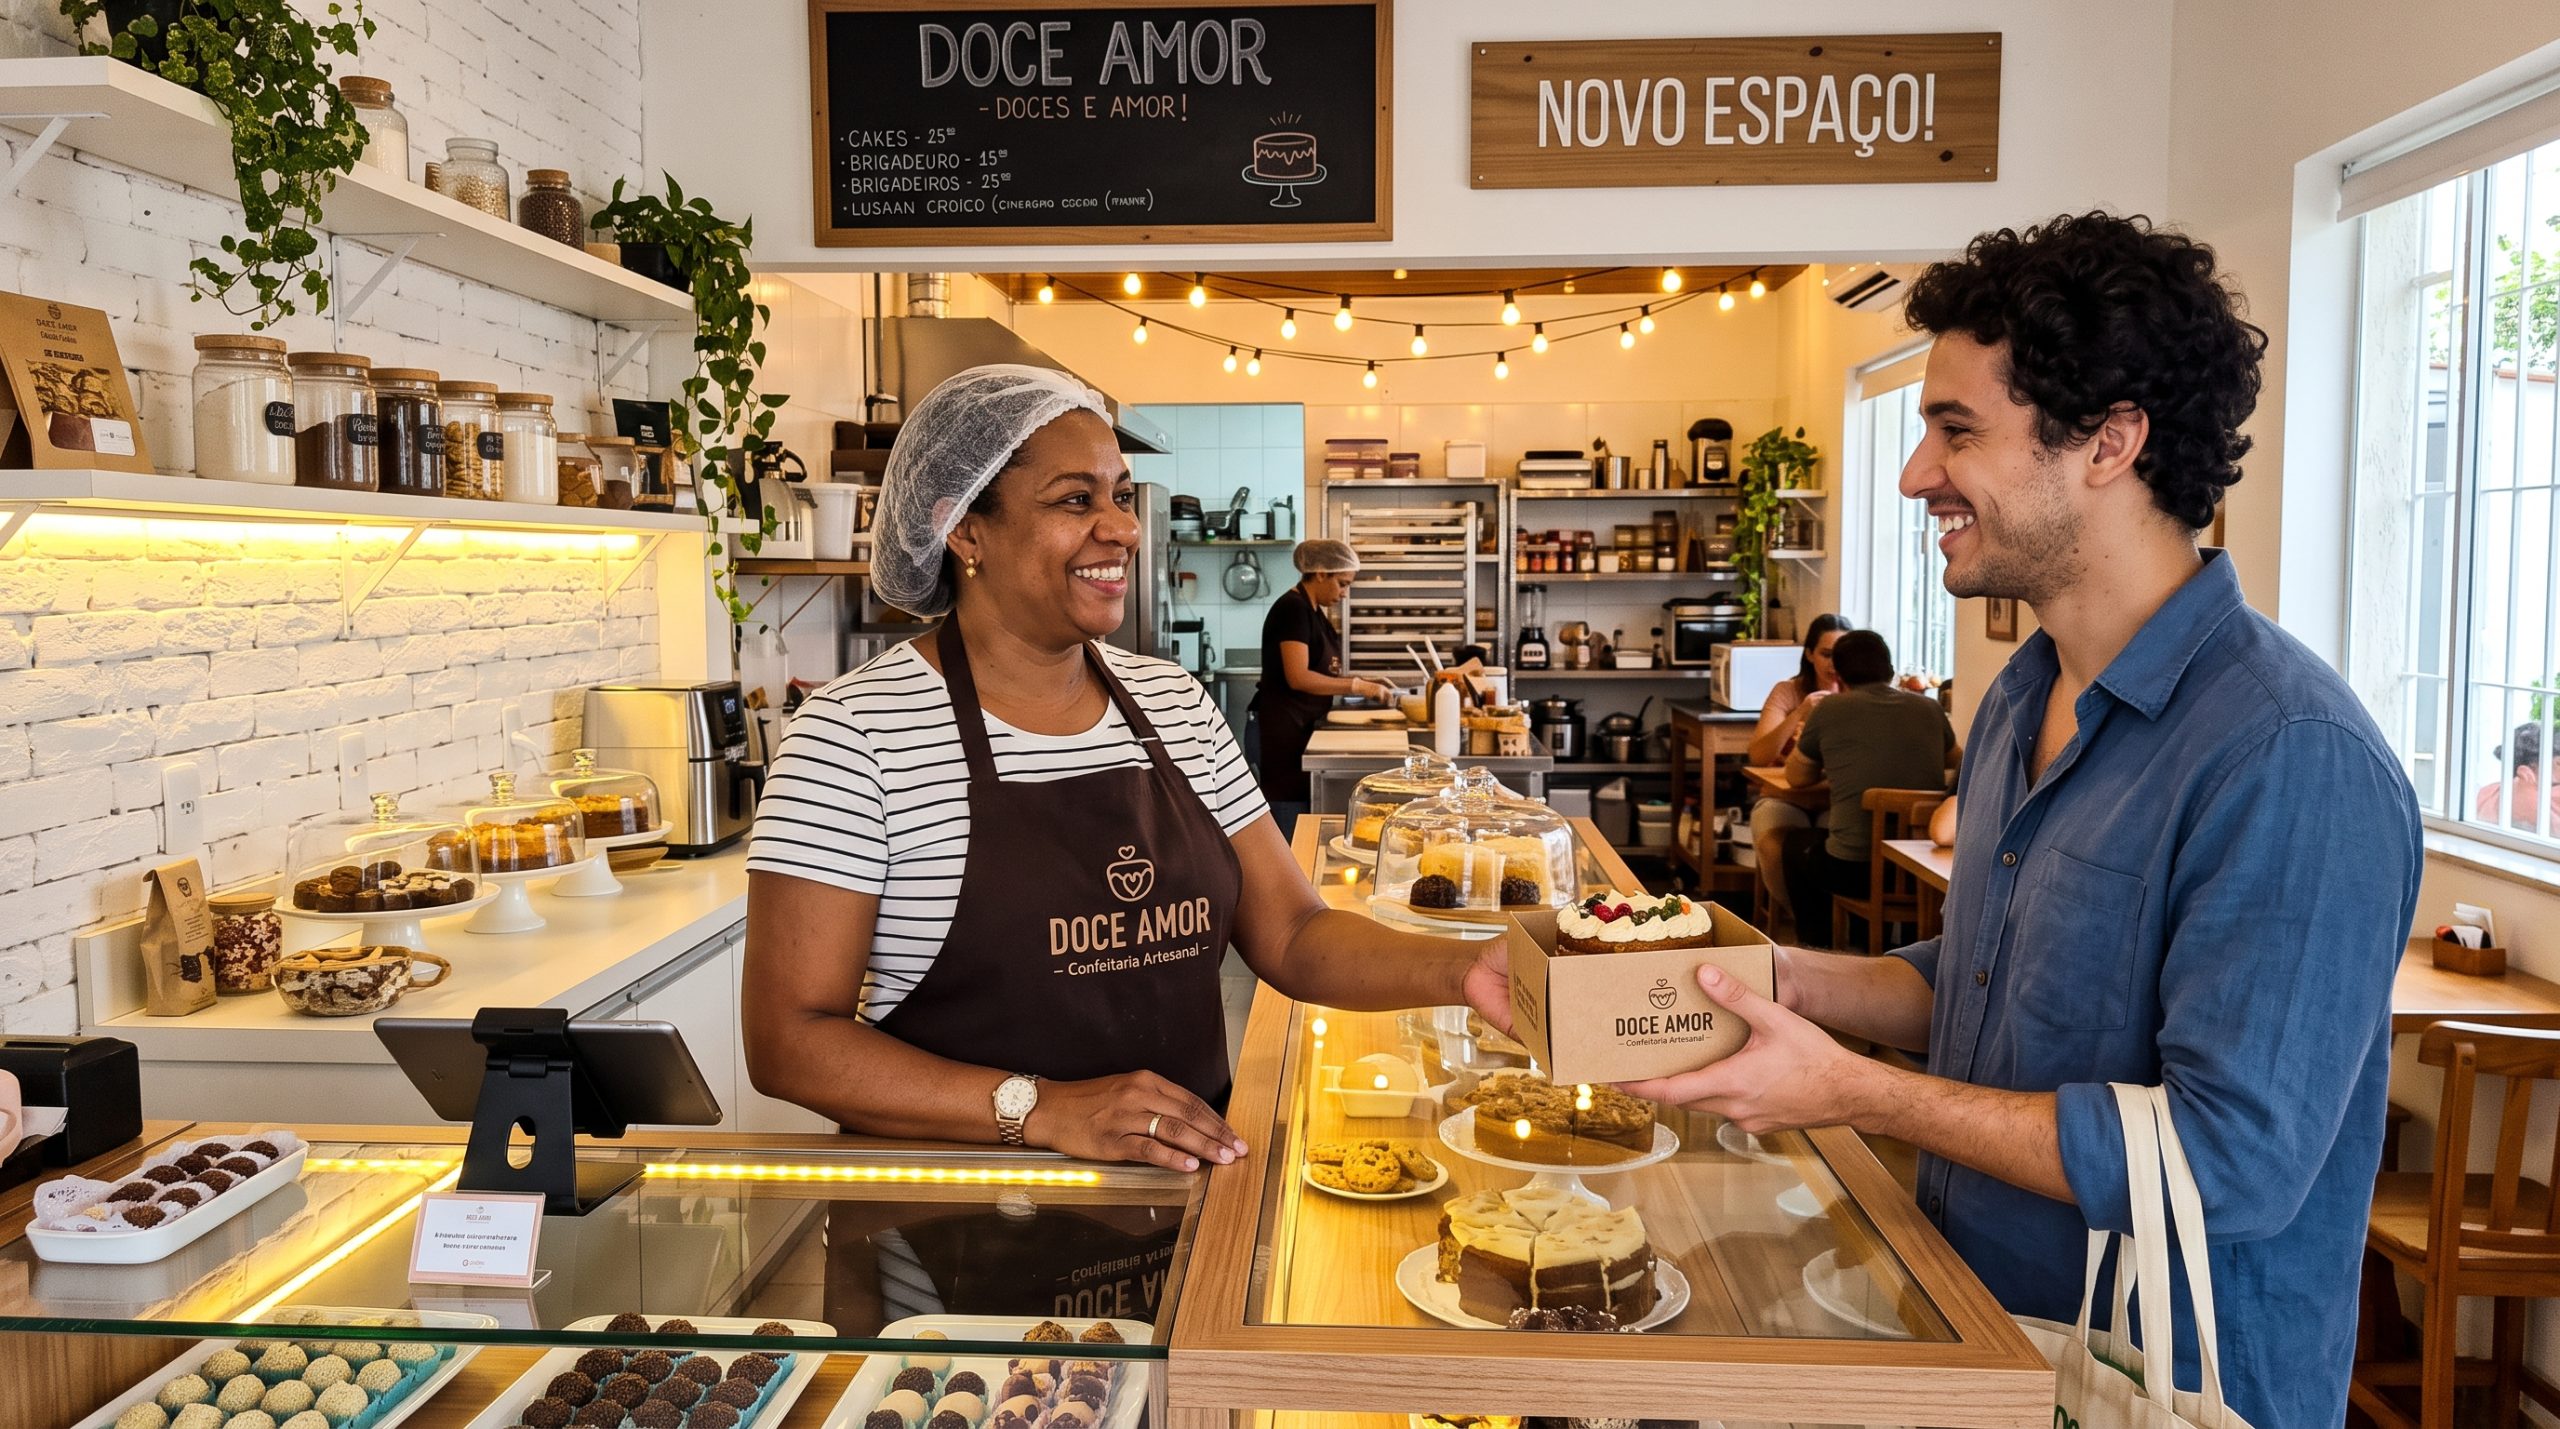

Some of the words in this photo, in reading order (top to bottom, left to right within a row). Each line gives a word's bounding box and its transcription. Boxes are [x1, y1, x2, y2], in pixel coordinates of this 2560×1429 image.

[919, 21, 1073, 88] DOCE
[1099, 18, 1272, 85] AMOR
[996, 96, 1070, 119] DOCES
[1084, 96, 1097, 119] E
[1110, 93, 1187, 122] AMOR!
[1538, 77, 1686, 148] NOVO
[1704, 73, 1936, 158] ESPAÇO!
[848, 130, 908, 148] CAKES
[850, 153, 960, 172] BRIGADEURO
[851, 176, 960, 195] BRIGADEIROS
[852, 201, 915, 216] LUSAAN
[1050, 911, 1127, 956] DOCE
[1137, 897, 1211, 945] AMOR
[1068, 955, 1140, 976] Confeitaria
[1143, 942, 1199, 967] Artesanal
[1616, 1016, 1659, 1037] DOCE
[1664, 1012, 1713, 1033] AMOR
[1669, 1034, 1705, 1044] Artesanal
